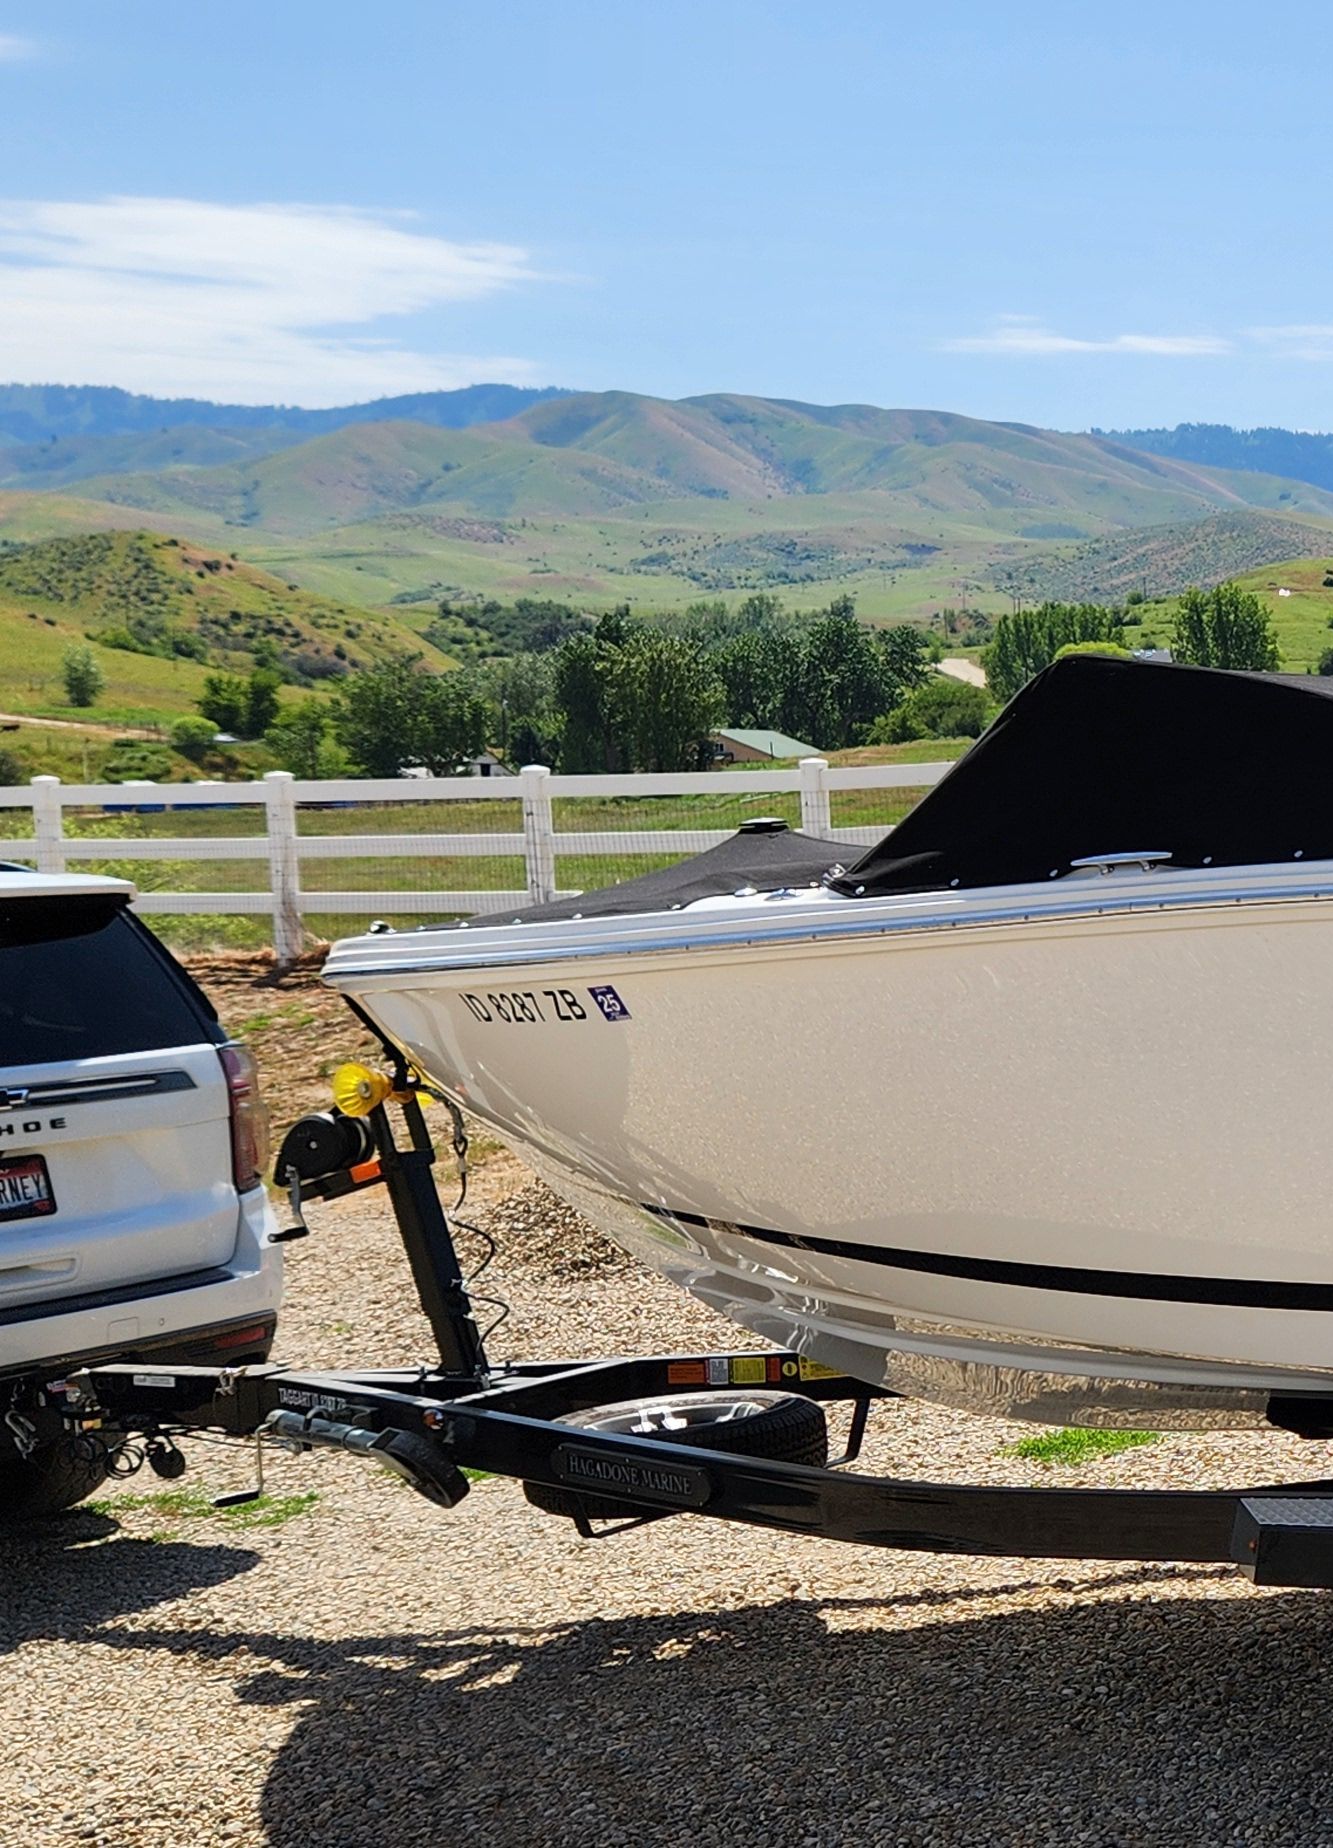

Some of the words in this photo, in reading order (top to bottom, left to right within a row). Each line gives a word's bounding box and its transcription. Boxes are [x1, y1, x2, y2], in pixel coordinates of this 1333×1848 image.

[458, 993, 493, 1022] ID
[487, 992, 546, 1023] 8287
[542, 989, 587, 1021] ZB
[597, 994, 621, 1013] 25
[569, 1455, 639, 1485] HAGADONE
[641, 1469, 692, 1495] MARINE
